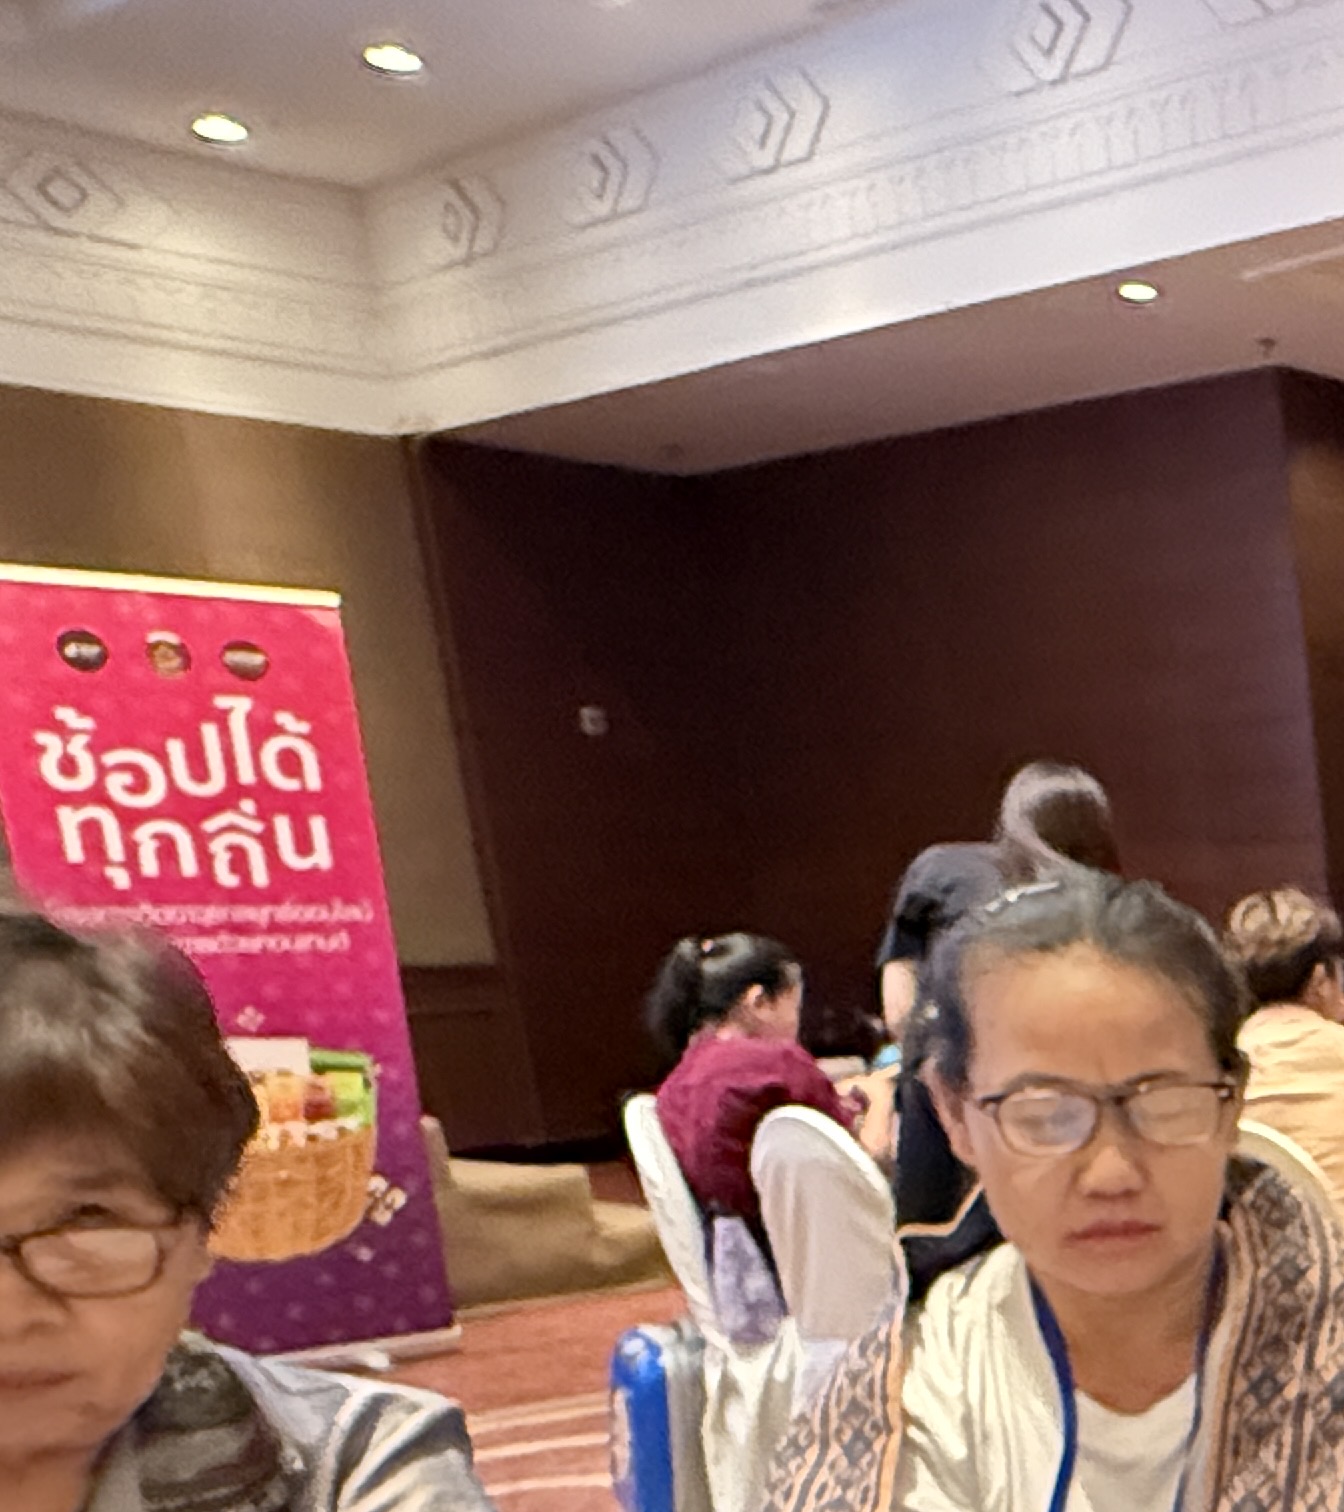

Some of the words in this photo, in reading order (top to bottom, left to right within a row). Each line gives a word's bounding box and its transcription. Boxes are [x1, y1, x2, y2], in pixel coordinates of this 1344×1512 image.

[35, 695, 323, 808] ช้อปได้
[55, 799, 333, 889] ทุกถิ่น
